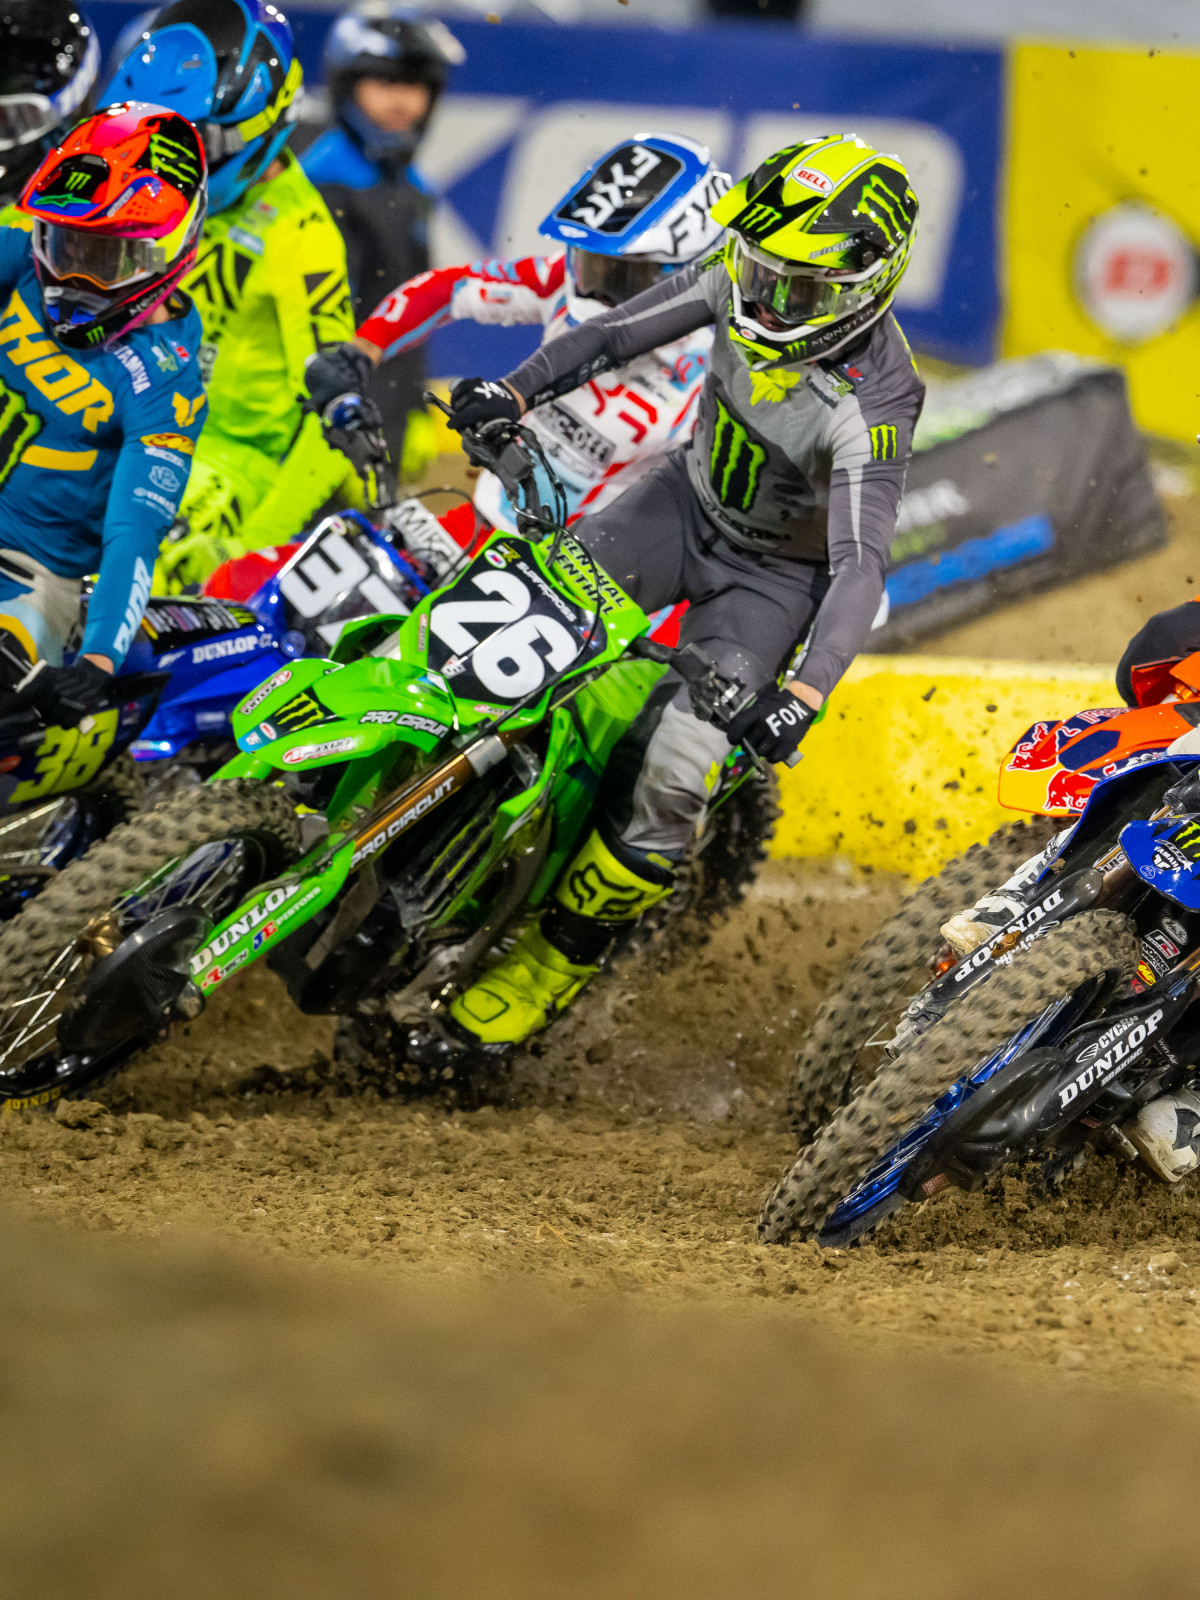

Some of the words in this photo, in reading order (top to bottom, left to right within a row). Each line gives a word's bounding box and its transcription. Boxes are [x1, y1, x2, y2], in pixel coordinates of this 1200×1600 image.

[572, 145, 661, 229] FXR
[798, 168, 827, 190] BELL
[0, 289, 115, 434] THOR
[192, 634, 259, 664] DUNLOP
[429, 569, 578, 699] 26
[360, 710, 400, 725] PRO
[764, 698, 811, 738] FOX
[8, 707, 119, 804] 38
[386, 780, 454, 838] CIRCUIT
[1154, 846, 1182, 873] YAMAHA
[1058, 1008, 1165, 1110] DUNLOP
[1101, 1046, 1144, 1088] BRAKING
